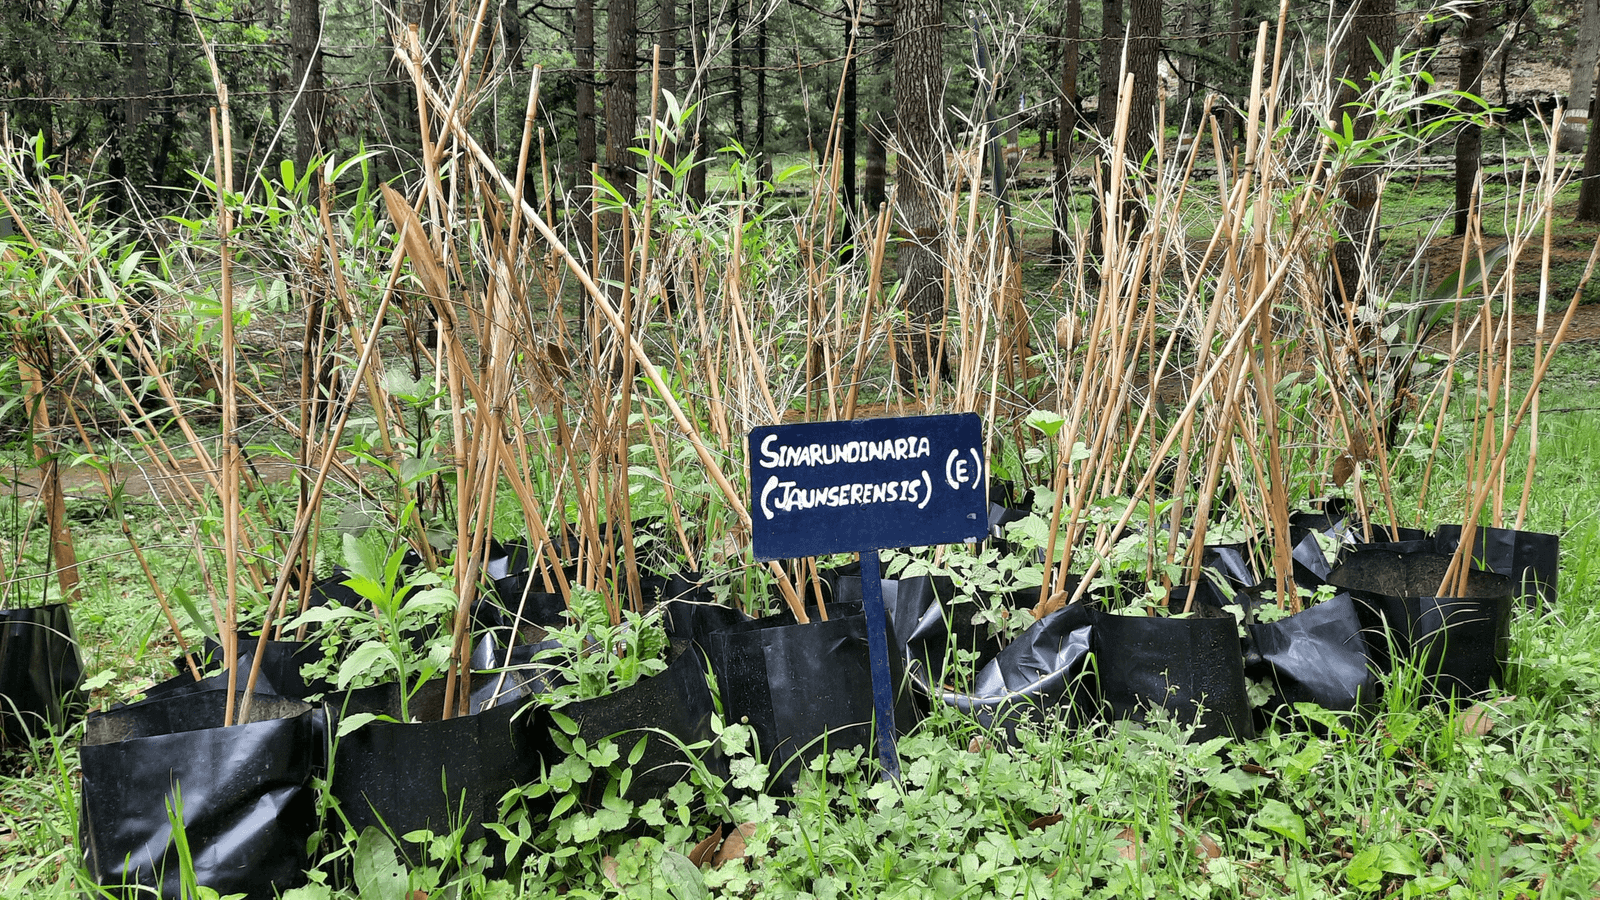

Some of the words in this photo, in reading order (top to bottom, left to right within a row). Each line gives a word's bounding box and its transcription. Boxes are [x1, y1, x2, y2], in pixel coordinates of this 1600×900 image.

[759, 433, 931, 469] SINARUNDINARIA
[945, 447, 983, 490] (E)
[760, 470, 933, 521] (JAUNSERENSIS)
